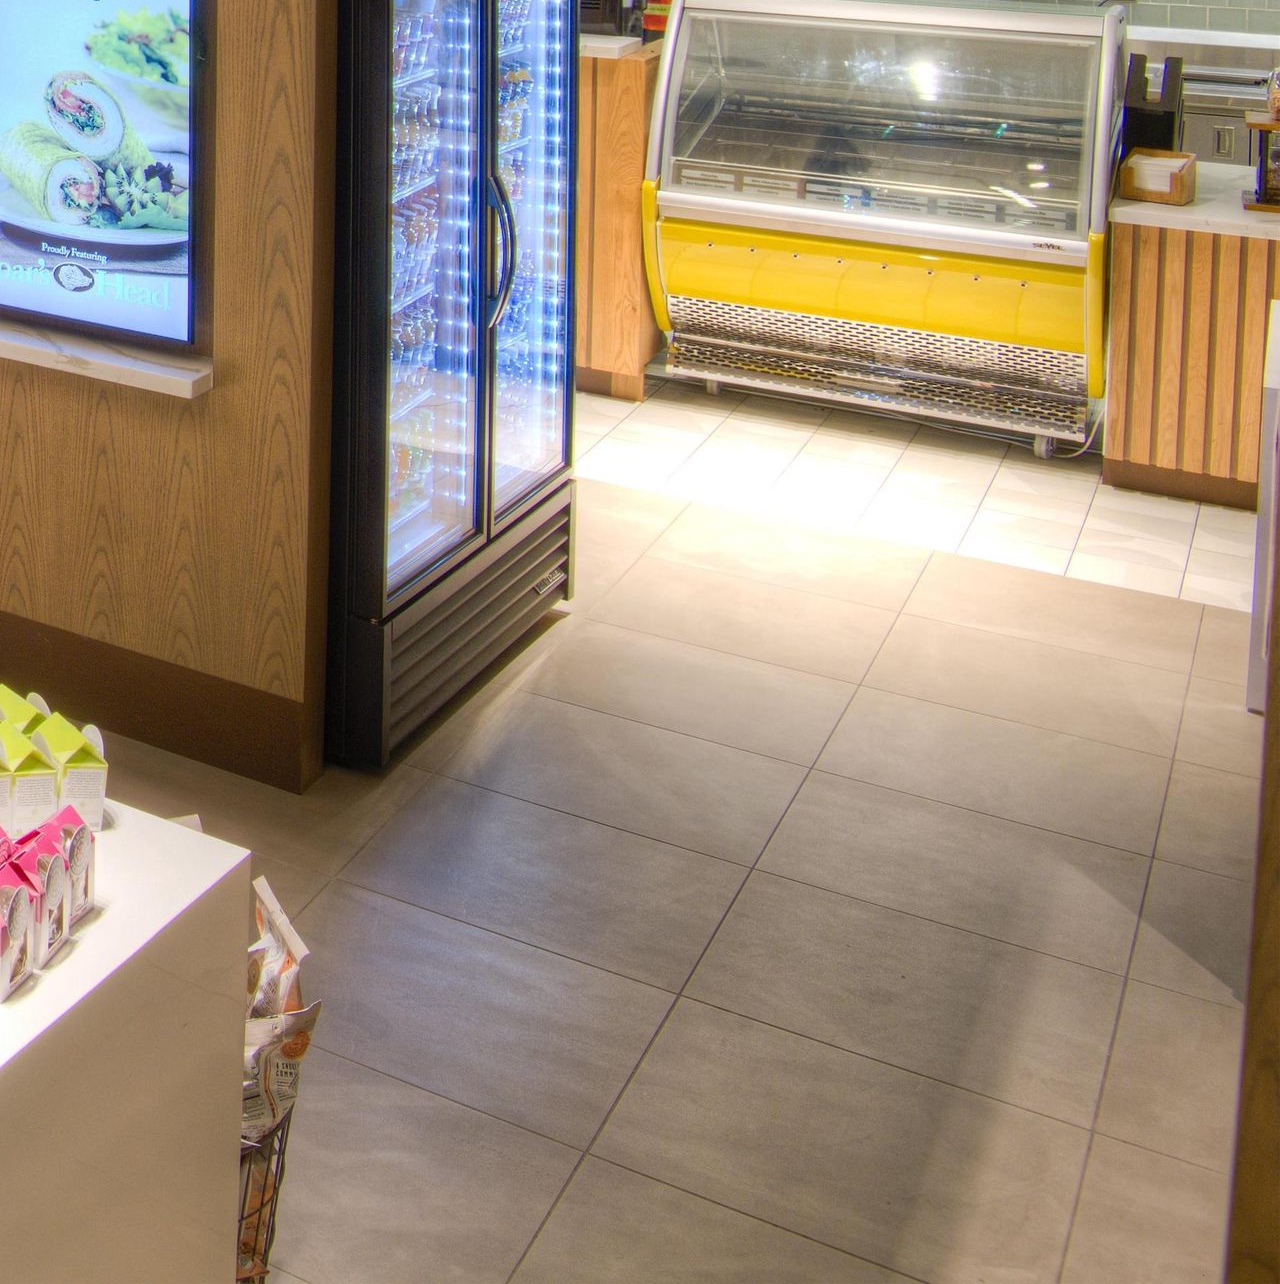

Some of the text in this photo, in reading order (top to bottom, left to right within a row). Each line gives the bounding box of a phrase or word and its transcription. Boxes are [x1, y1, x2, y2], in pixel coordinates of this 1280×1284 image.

[41, 242, 109, 265] Proudly Featuring
[95, 269, 171, 310] Head
